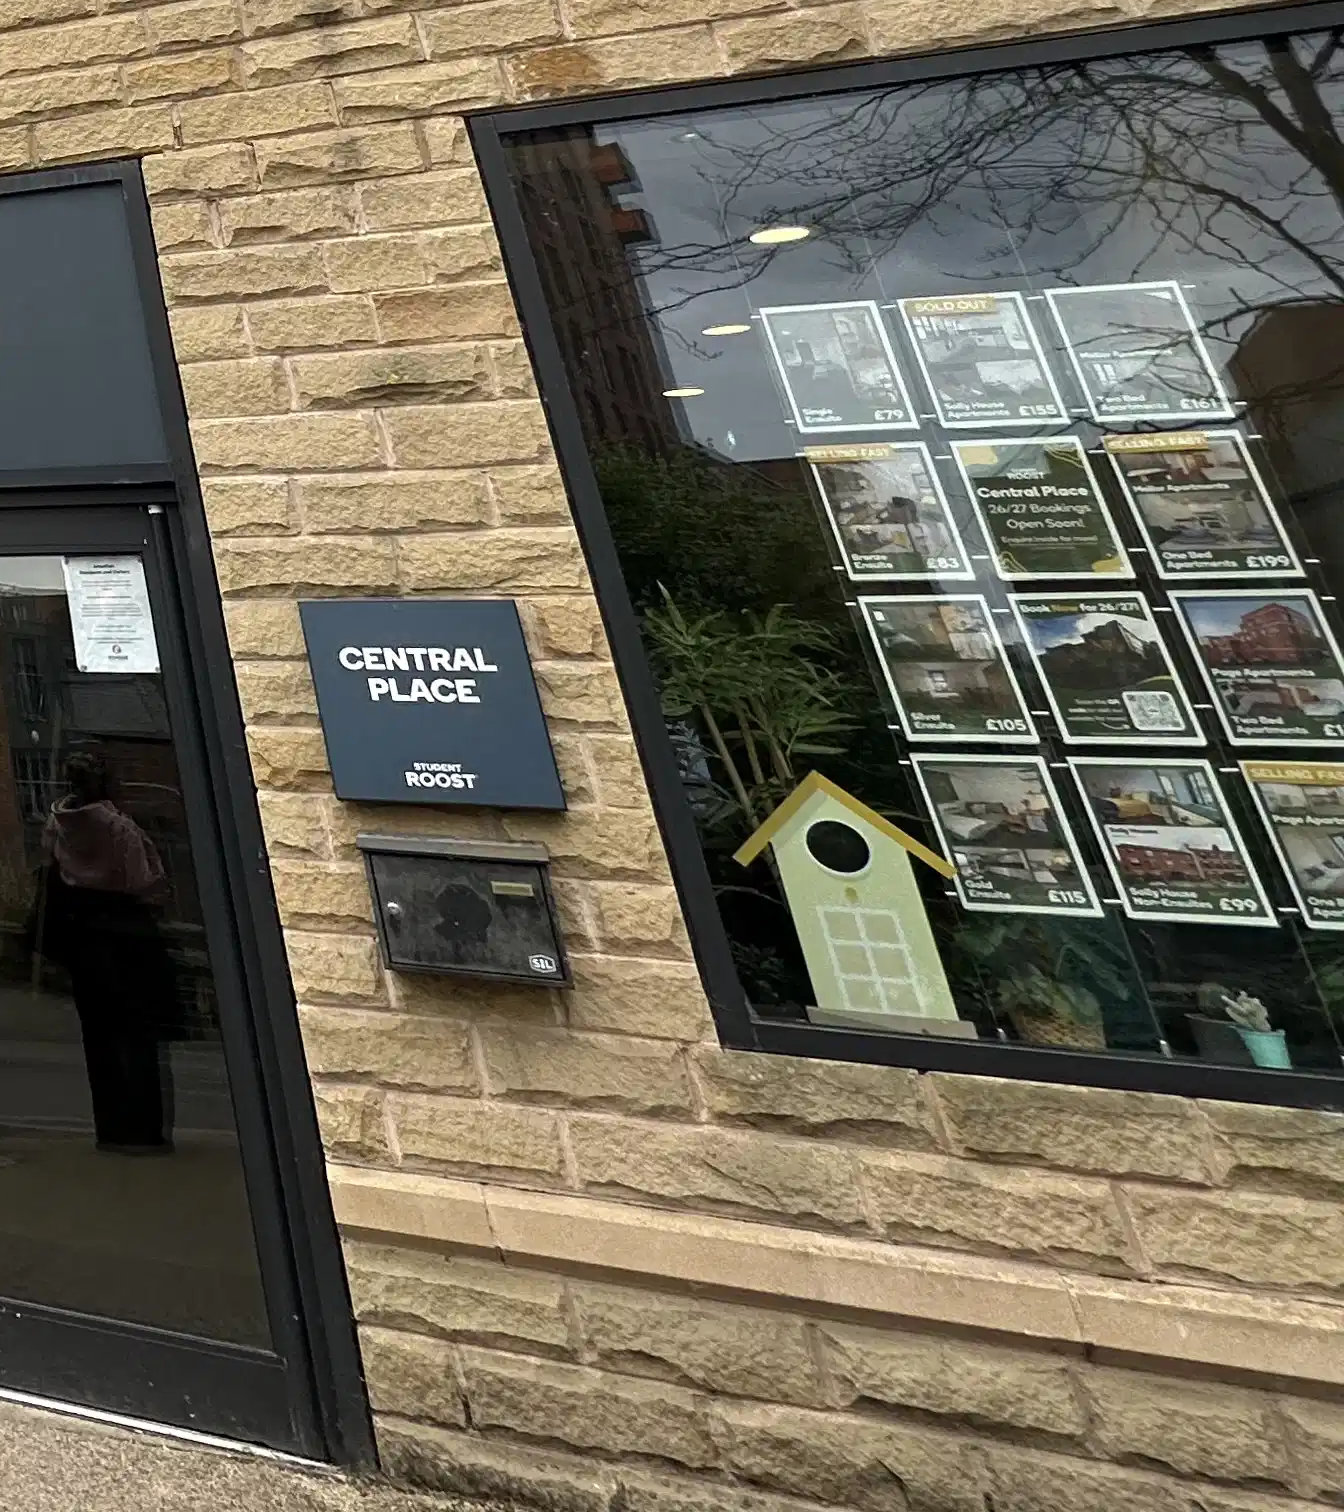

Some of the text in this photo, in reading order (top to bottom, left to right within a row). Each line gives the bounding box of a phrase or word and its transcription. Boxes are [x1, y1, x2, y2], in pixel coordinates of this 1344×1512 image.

[914, 299, 987, 313] SOLD OUT
[874, 409, 904, 421] £79
[1019, 404, 1058, 416] £155
[976, 486, 1089, 498] Central Place
[988, 503, 1092, 515] 26/27 Bookings
[1006, 518, 1085, 530] Open Soon!
[1167, 560, 1239, 570] Apartments
[1246, 555, 1290, 568] £199
[1020, 604, 1050, 613] Book
[338, 646, 498, 673] CENTRAL
[367, 677, 481, 704] PLACE
[985, 718, 1027, 731] £105
[413, 762, 462, 773] STUDENT
[405, 771, 476, 789] ROOST
[1317, 769, 1344, 781] FAS
[965, 880, 993, 889] Gold
[1048, 890, 1086, 903] £115
[1219, 898, 1258, 912] £99
